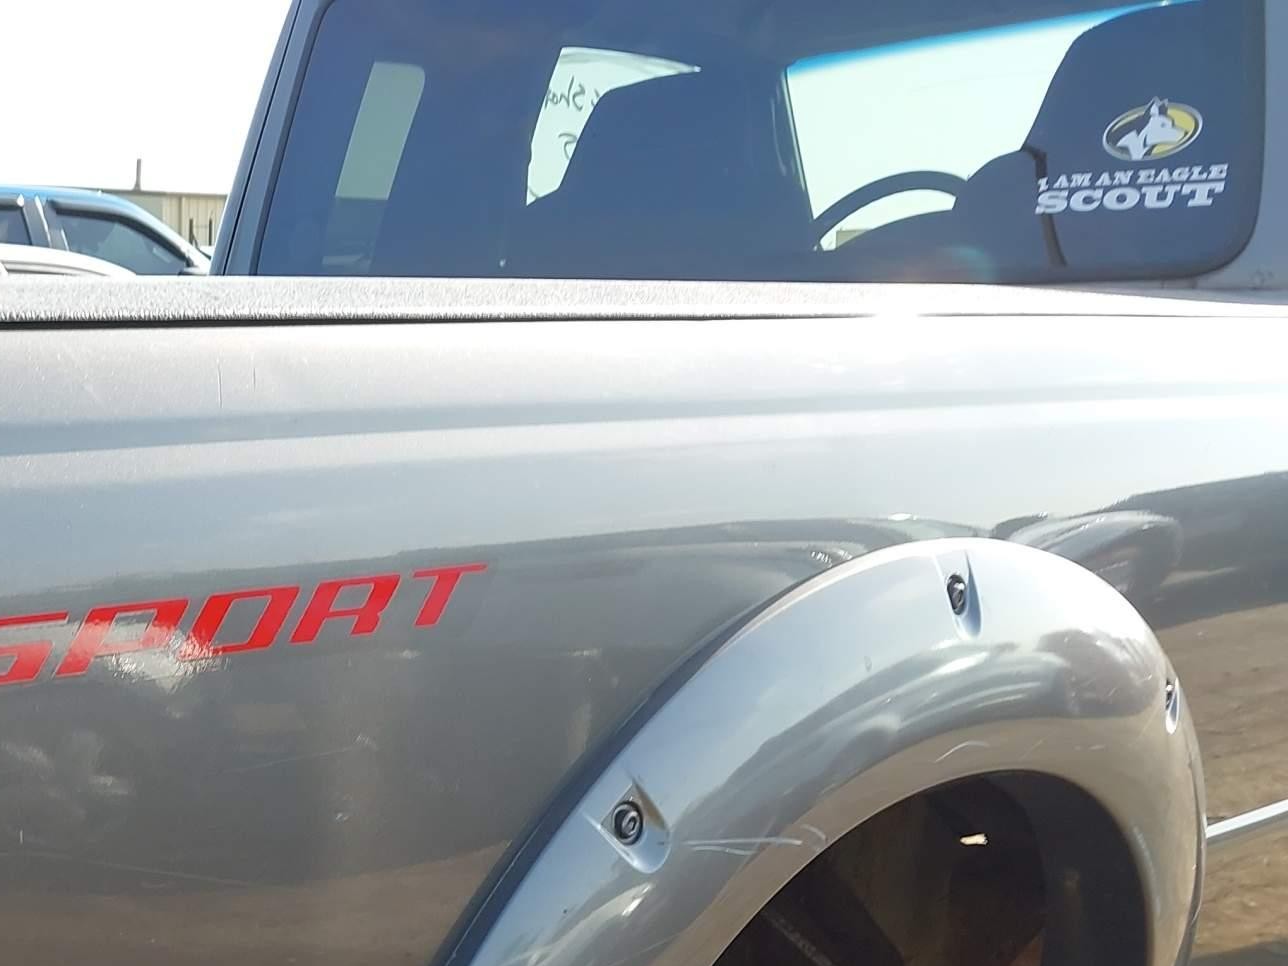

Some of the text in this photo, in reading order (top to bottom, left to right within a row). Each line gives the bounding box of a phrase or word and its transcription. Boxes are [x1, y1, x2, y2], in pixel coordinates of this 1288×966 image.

[1053, 172, 1093, 189] AM
[1095, 169, 1134, 187] AN
[1136, 163, 1229, 184] EAGLE
[1035, 180, 1225, 214] SCOUT
